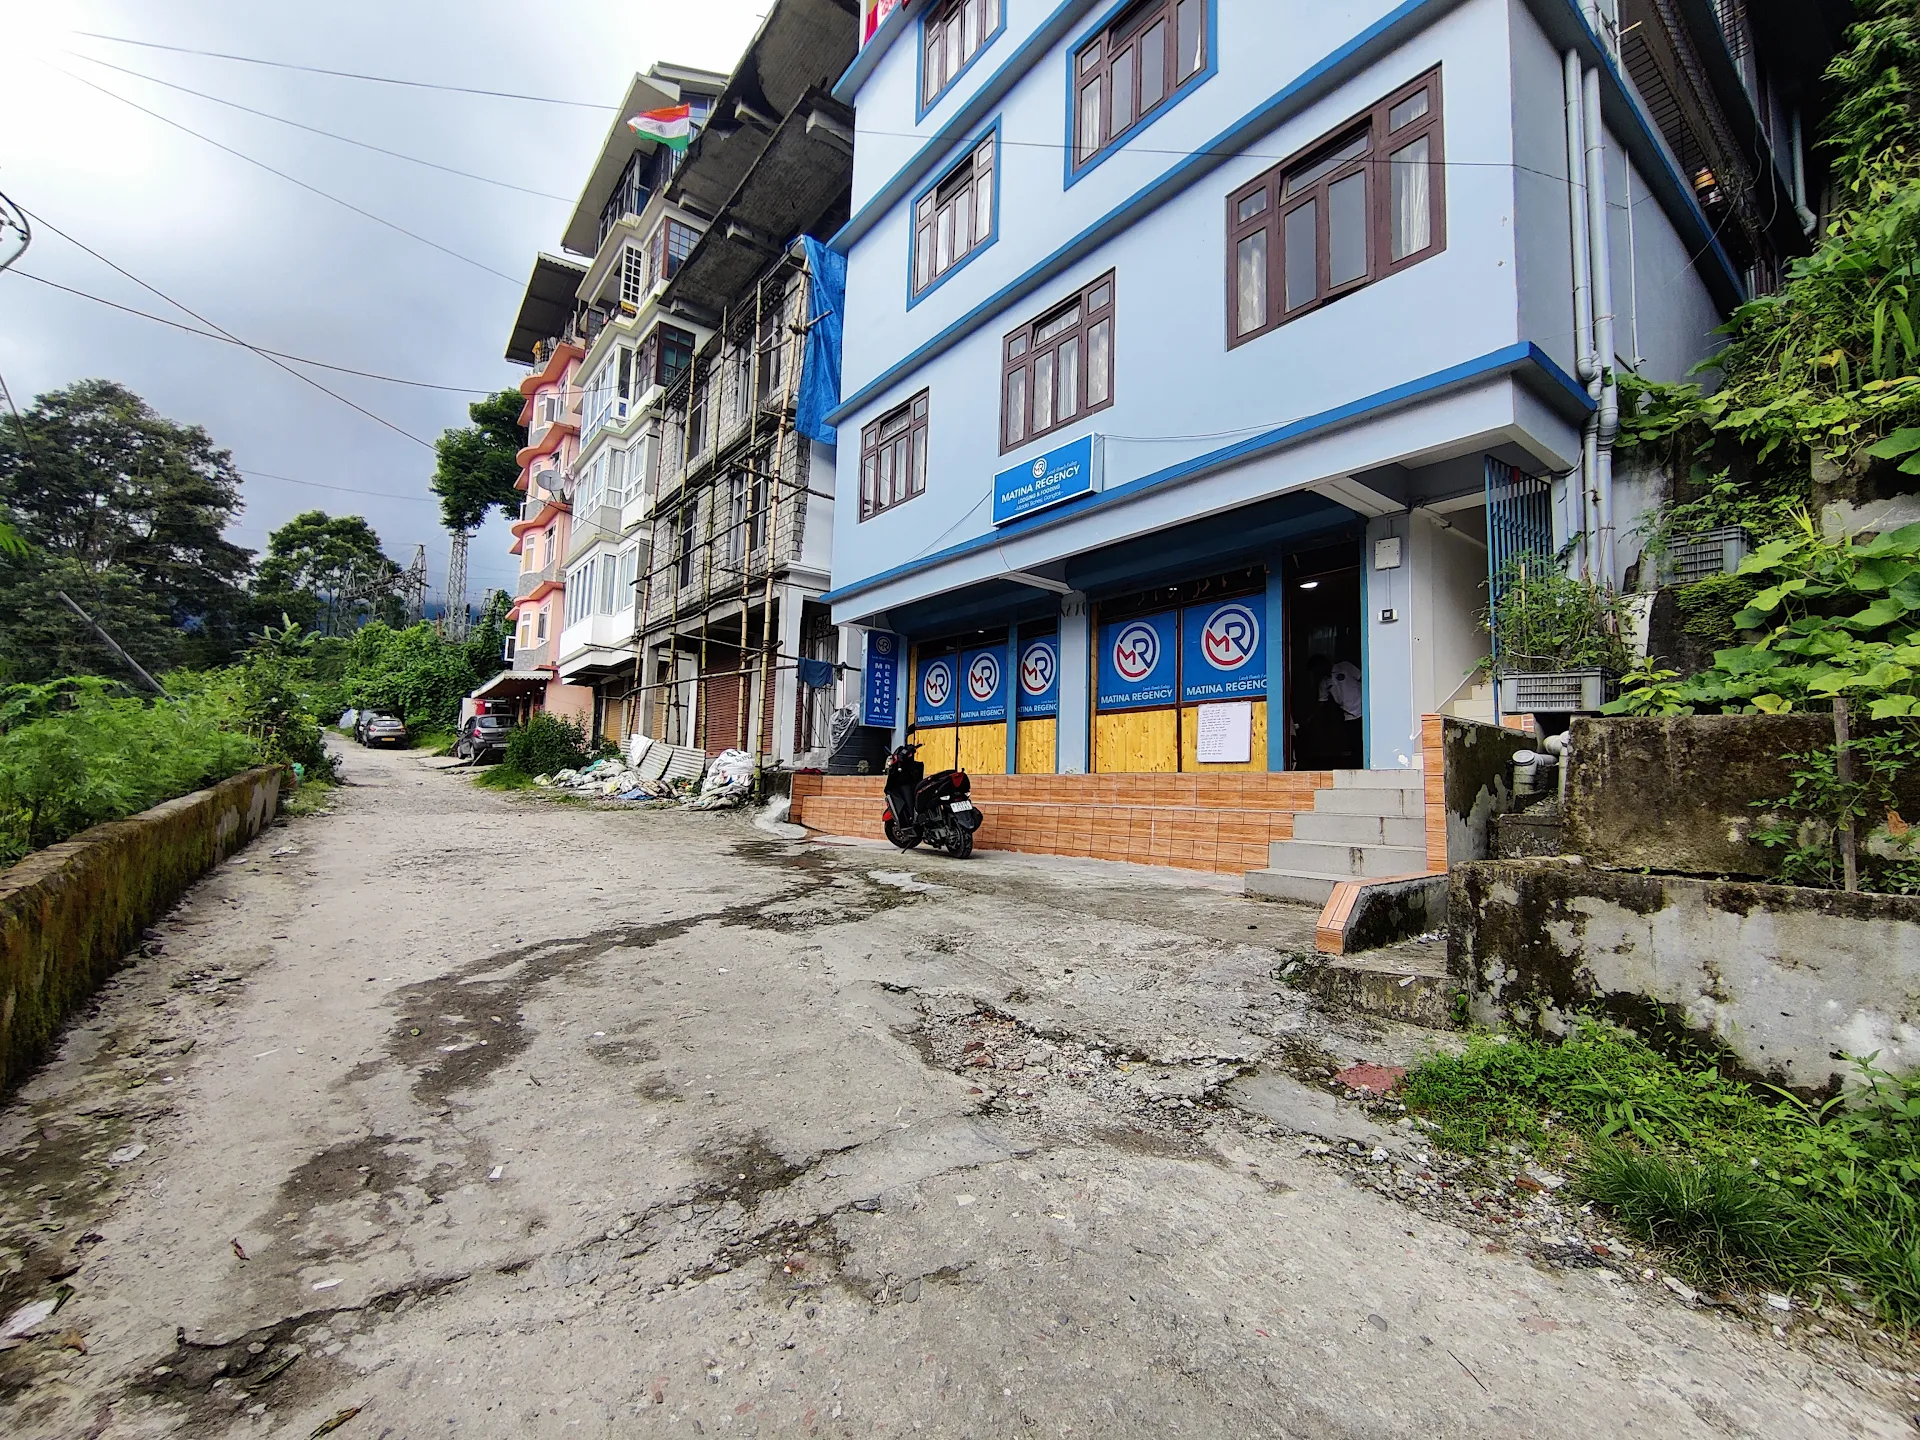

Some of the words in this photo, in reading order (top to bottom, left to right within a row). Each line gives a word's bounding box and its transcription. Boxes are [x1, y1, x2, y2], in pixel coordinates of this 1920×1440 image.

[1001, 483, 1033, 503] MATINA
[1036, 465, 1080, 490] REGENCY
[1018, 493, 1036, 504] LODGING
[874, 663, 883, 713] MATINA
[1187, 684, 1223, 696] MATINA
[1225, 679, 1267, 692] REGENC
[1101, 694, 1130, 704] MATINA
[1132, 690, 1173, 701] REGENCY
[961, 711, 979, 719] MATINA
[980, 708, 1005, 717] REGENCY
[1033, 703, 1058, 713] REGENC
[917, 715, 934, 723] MATINA
[934, 713, 955, 722] REGENCY
